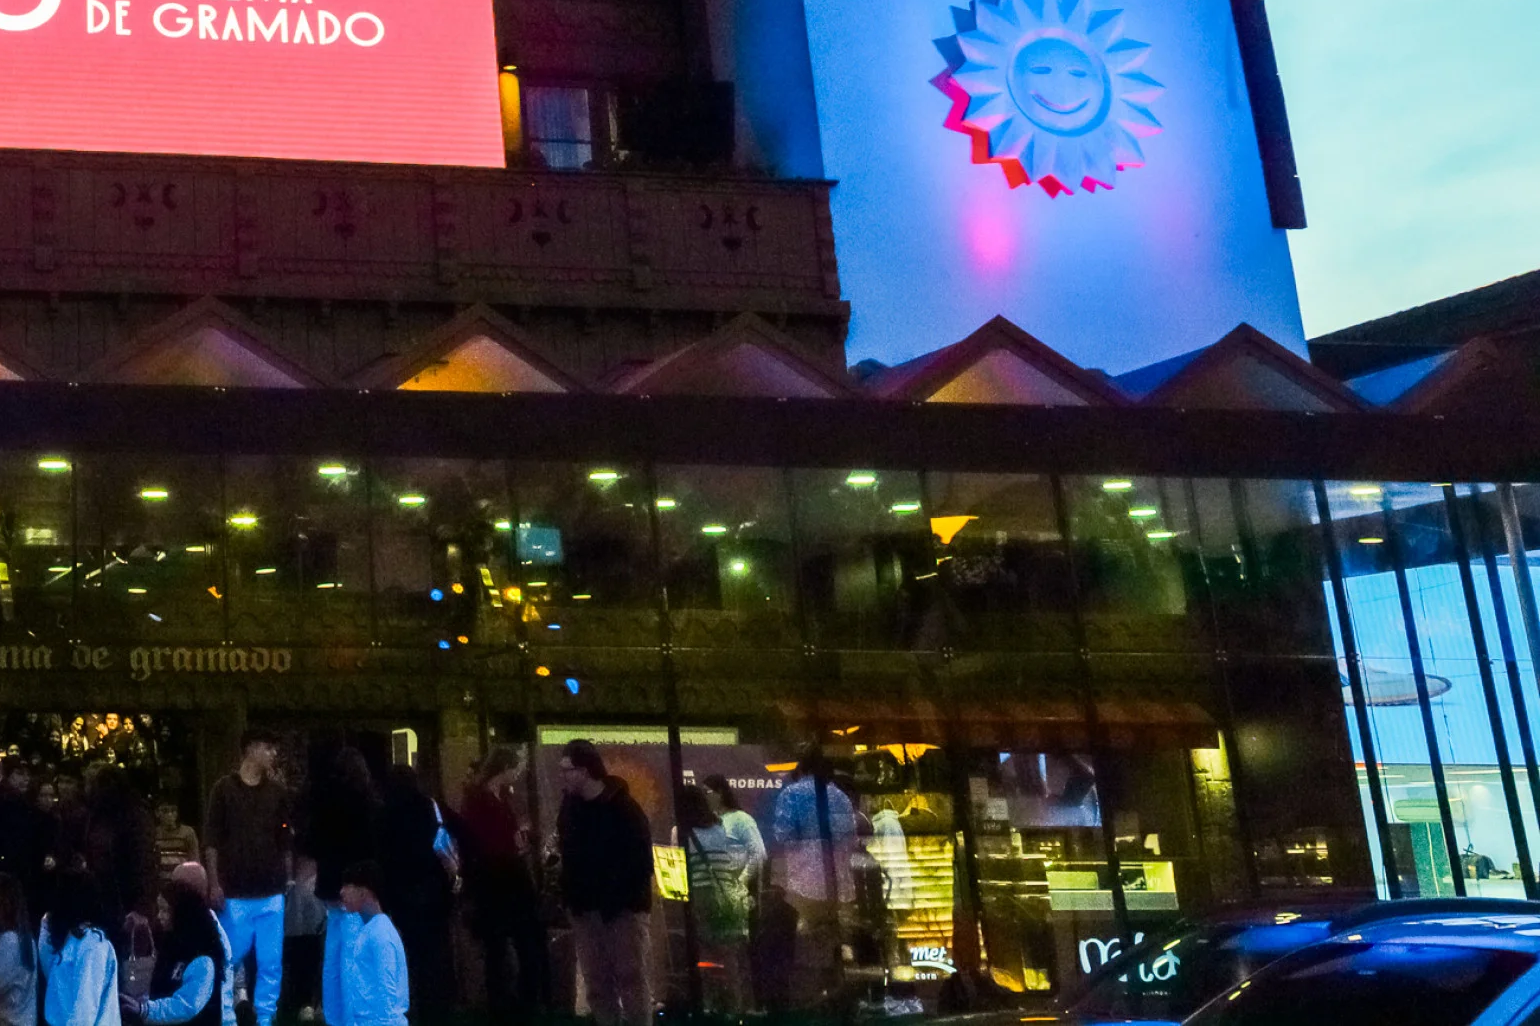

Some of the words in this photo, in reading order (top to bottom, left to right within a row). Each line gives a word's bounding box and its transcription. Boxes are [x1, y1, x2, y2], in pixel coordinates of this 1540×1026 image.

[86, 0, 132, 36] DE
[152, 2, 386, 48] GRAMADO
[71, 643, 113, 670] de
[129, 645, 293, 681] gramado
